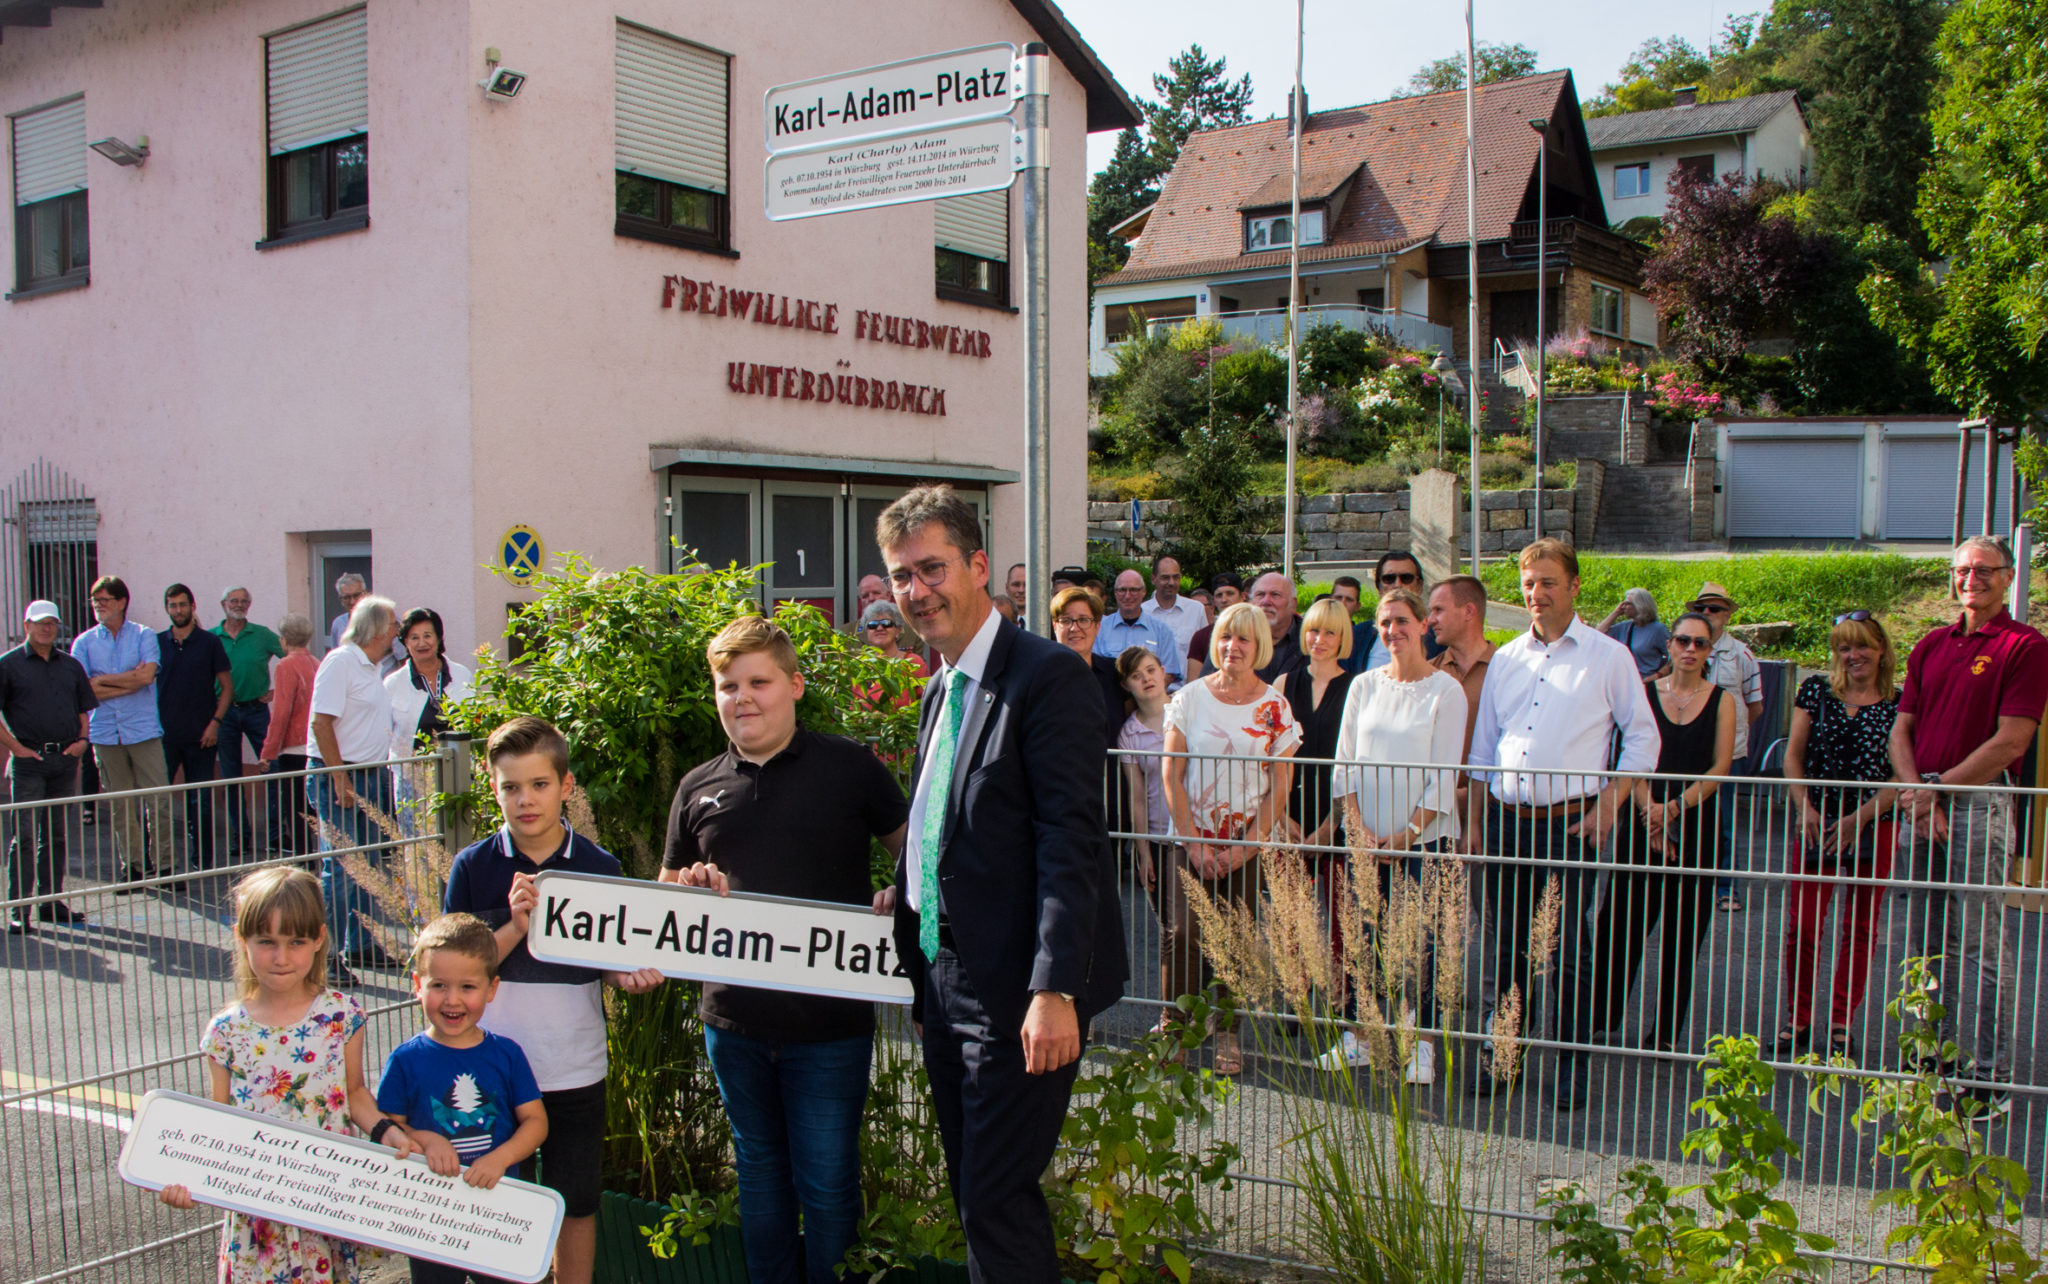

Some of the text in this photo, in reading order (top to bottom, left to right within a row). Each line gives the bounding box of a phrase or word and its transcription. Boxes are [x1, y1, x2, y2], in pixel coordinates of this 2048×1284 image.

[775, 67, 1007, 136] Karl-Adam-Platz
[780, 143, 1000, 188] geb. 07.10.1954 in Würzburg gest. 14.11.2014 in Würzburg
[783, 156, 996, 198] Kommandant der Freiwilligen Feuerwehr Unterdürrbach
[828, 139, 947, 164] Karl (Charly) Adam
[809, 174, 966, 206] Mitglied des Stadtrates von 2000 bis 2014
[662, 274, 993, 358] FREIWILLIGE FEUERWEHR
[727, 358, 947, 416] UNTERDÜRRBACH
[796, 549, 805, 577] 1
[159, 1129, 533, 1232] geb. 07.10.1954 in Würzburg gest. 14.11.2014 in Würzburg
[252, 1130, 455, 1190] Karl (Charly) Adam
[159, 1145, 523, 1245] Kommandant der Freiwilligen Feuerwehr Unterdürrbach
[203, 1175, 262, 1198] Mitglied
[263, 1190, 285, 1204] des
[288, 1196, 356, 1222] Stadtrates
[360, 1216, 384, 1229] von
[440, 1234, 470, 1251] 2014
